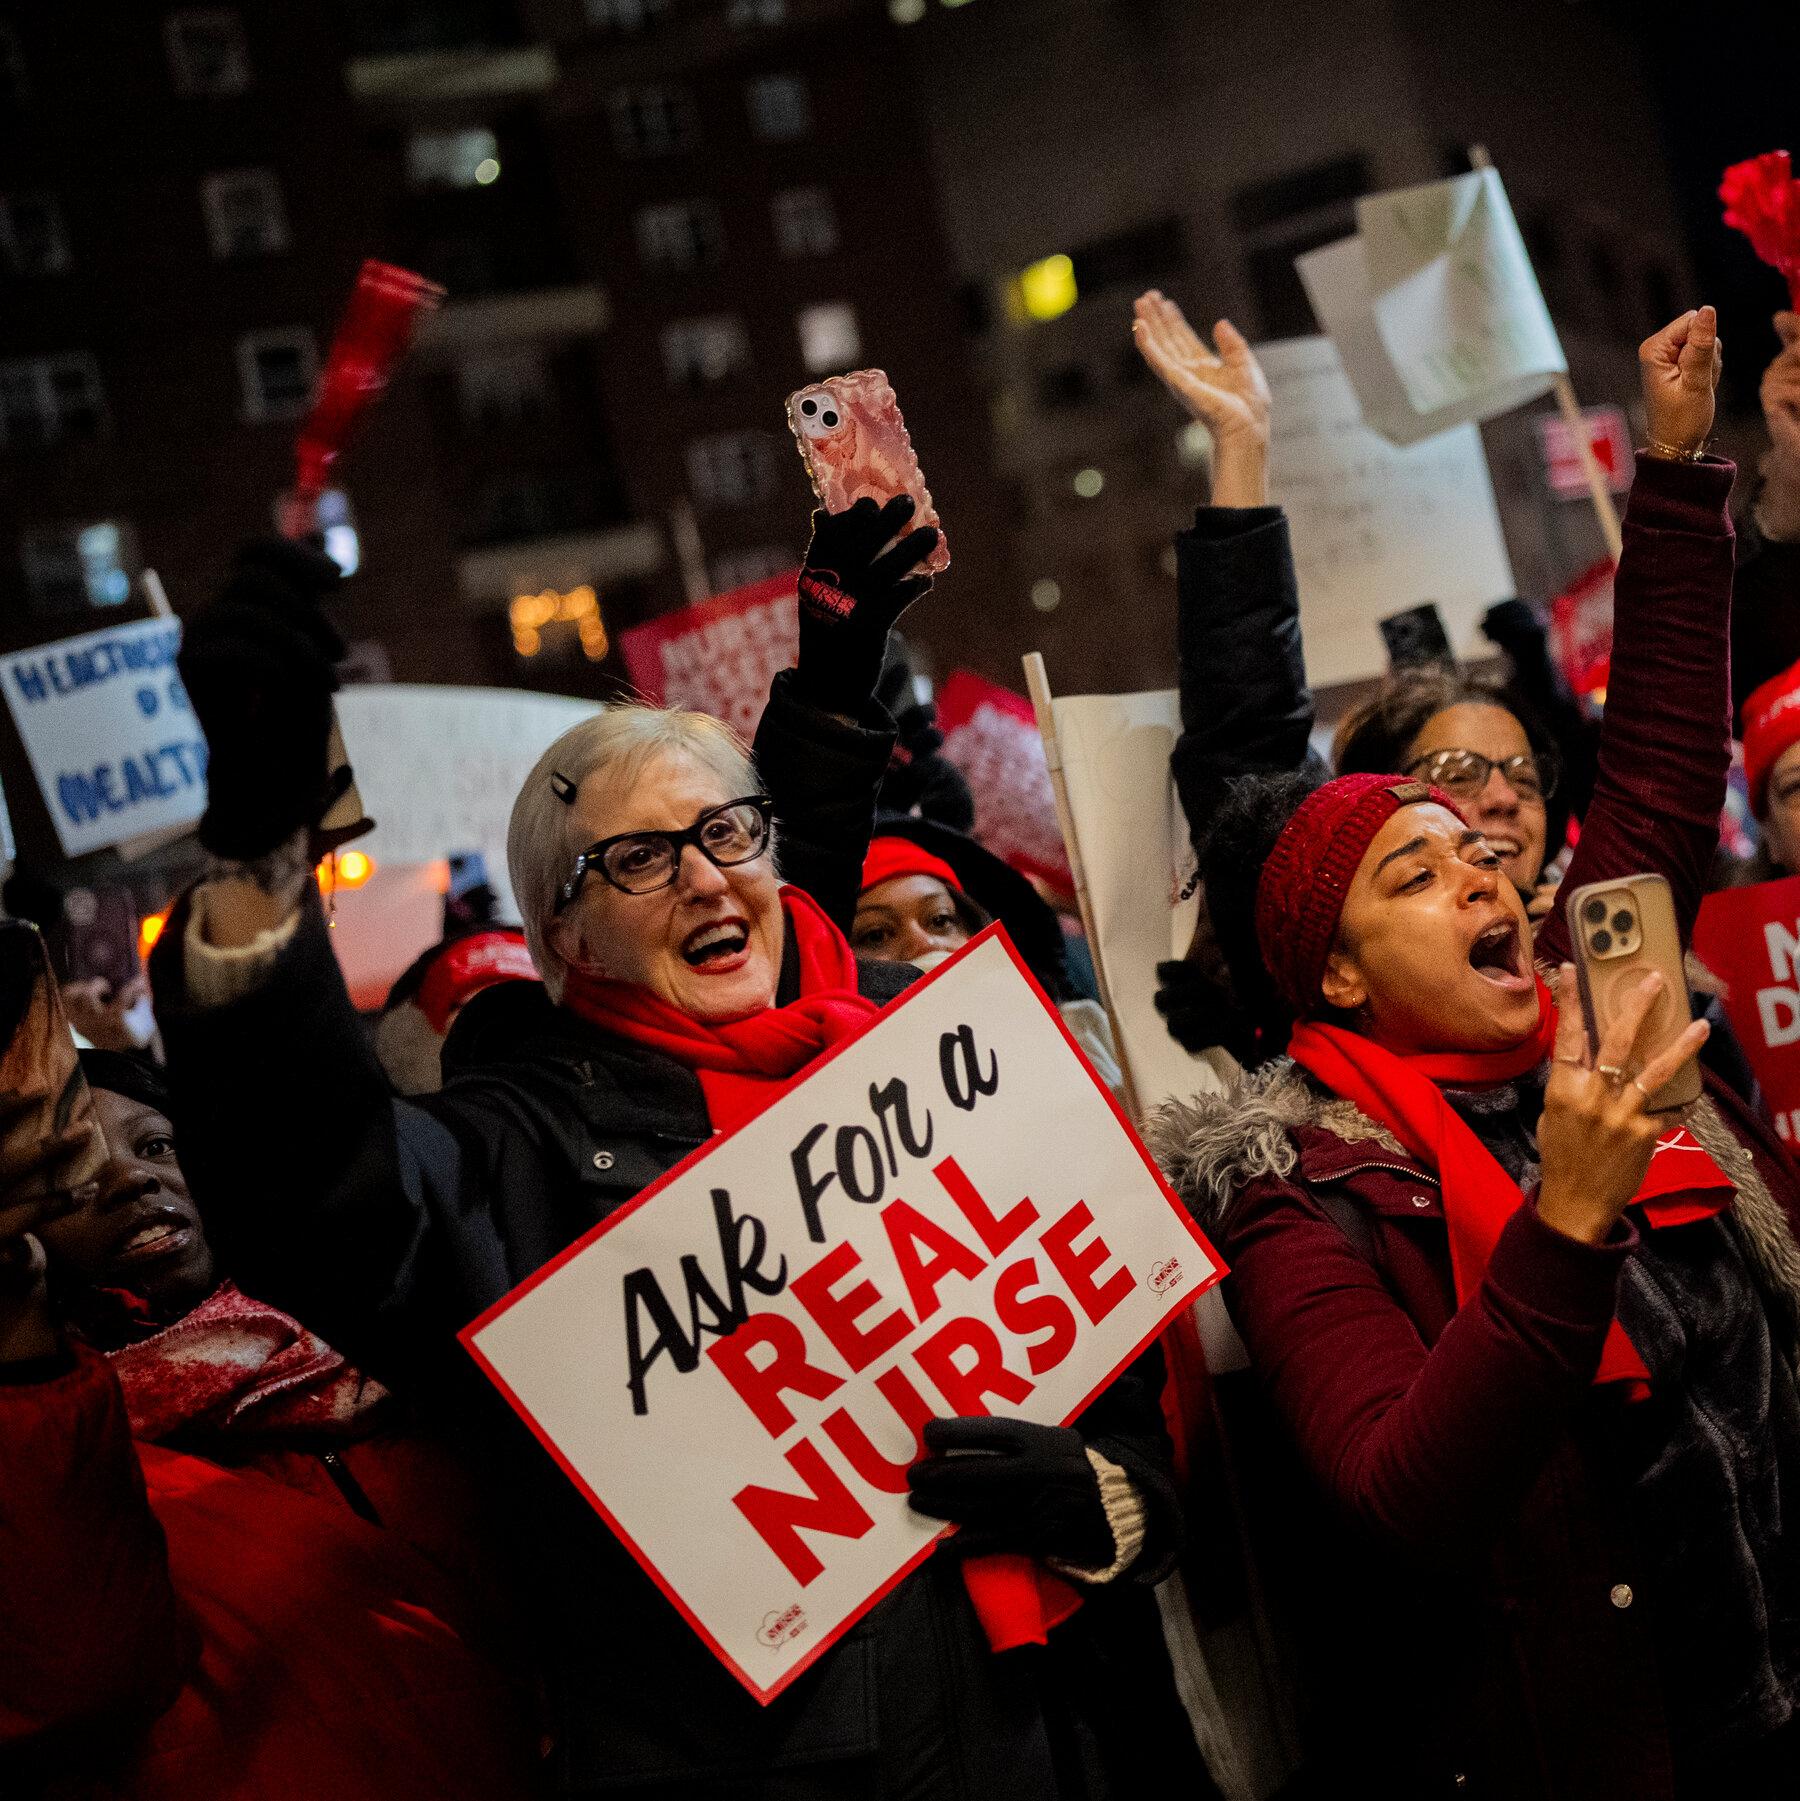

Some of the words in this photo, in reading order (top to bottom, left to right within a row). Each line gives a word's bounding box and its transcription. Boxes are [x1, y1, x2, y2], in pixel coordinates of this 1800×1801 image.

[623, 1188, 787, 1415] Ask
[939, 1024, 999, 1111] a
[706, 1155, 1041, 1440] REAL
[732, 1198, 1137, 1588] NURSE
